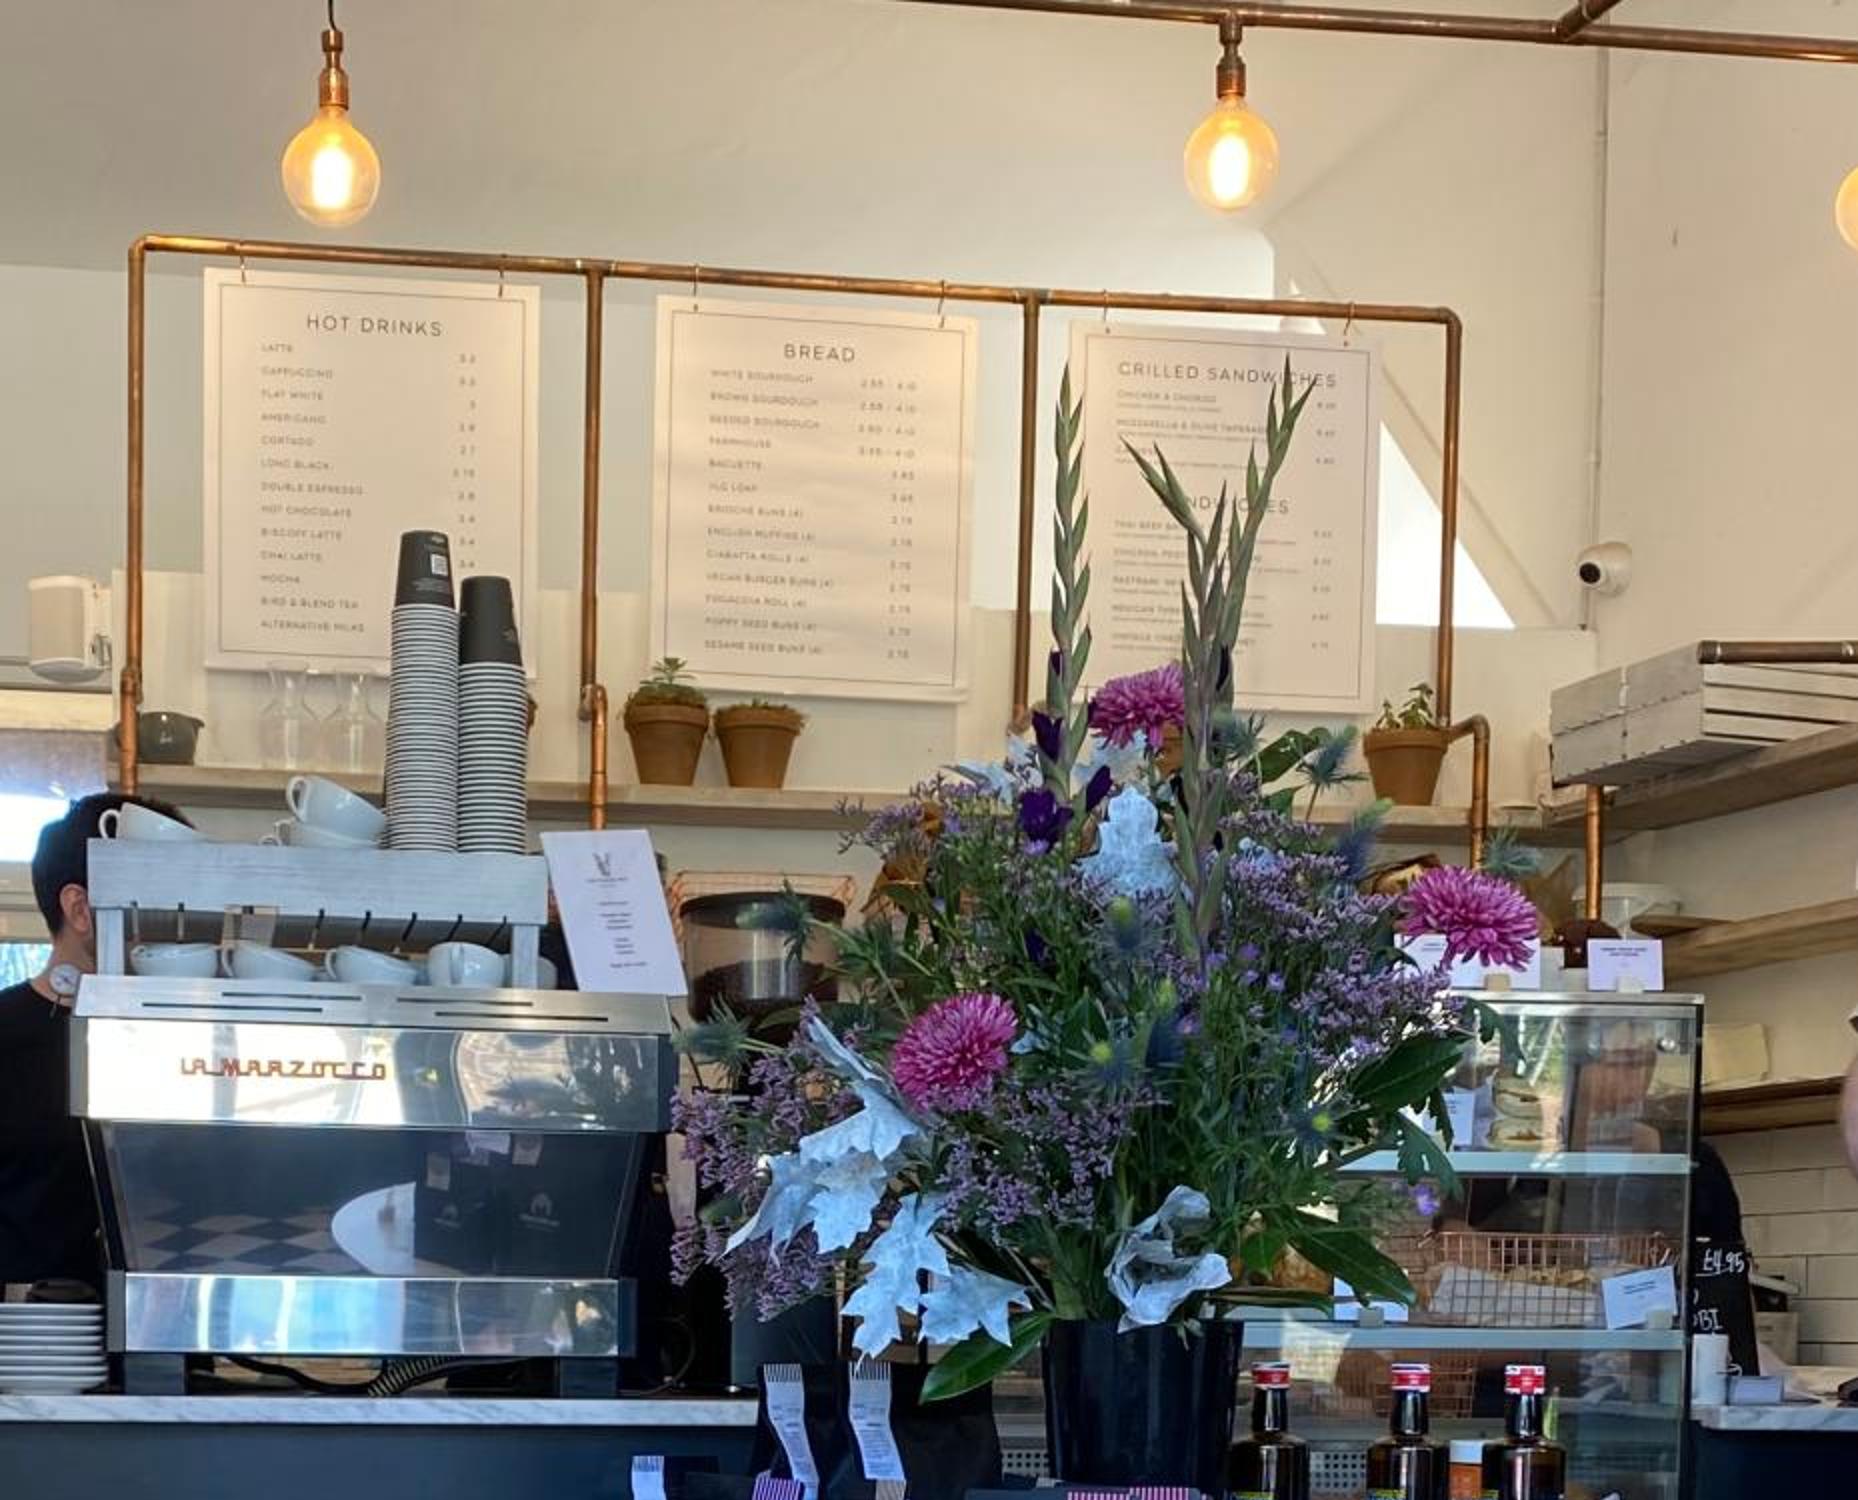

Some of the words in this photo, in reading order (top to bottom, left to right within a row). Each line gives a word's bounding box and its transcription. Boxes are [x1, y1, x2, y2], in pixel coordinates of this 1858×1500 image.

[306, 314, 350, 332] HOT
[360, 317, 442, 337] DRINKS
[784, 343, 856, 363] BREAD
[181, 1057, 206, 1075] LA
[221, 1058, 386, 1080] MARZOCCO
